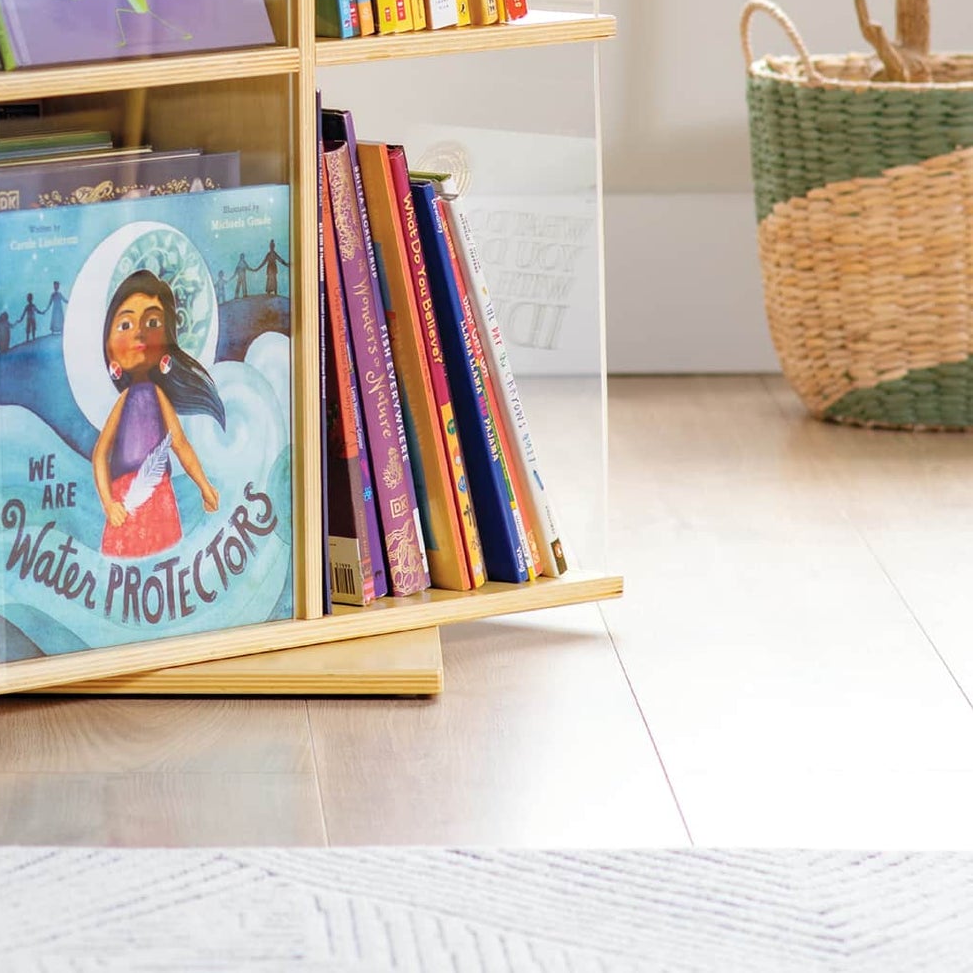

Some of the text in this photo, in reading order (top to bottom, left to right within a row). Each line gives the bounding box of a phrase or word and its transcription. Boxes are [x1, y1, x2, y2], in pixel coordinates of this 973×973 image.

[0, 197, 17, 210] DK
[211, 217, 245, 231] Michaela
[361, 206, 378, 279] TECKENTRUP
[403, 191, 443, 364] What Do You Believe?
[352, 279, 392, 439] Wonders Nature
[380, 324, 393, 357] FISH
[490, 326, 502, 347] DAY
[386, 361, 409, 463] EVERYWHERE
[459, 318, 474, 357] LLAMA
[469, 357, 484, 395] LLAMA
[483, 417, 500, 463] PAJAMA
[28, 453, 77, 510] WE ARE
[393, 499, 408, 513] DK
[1, 498, 97, 610] Water
[104, 481, 278, 625] PROTECTORS
